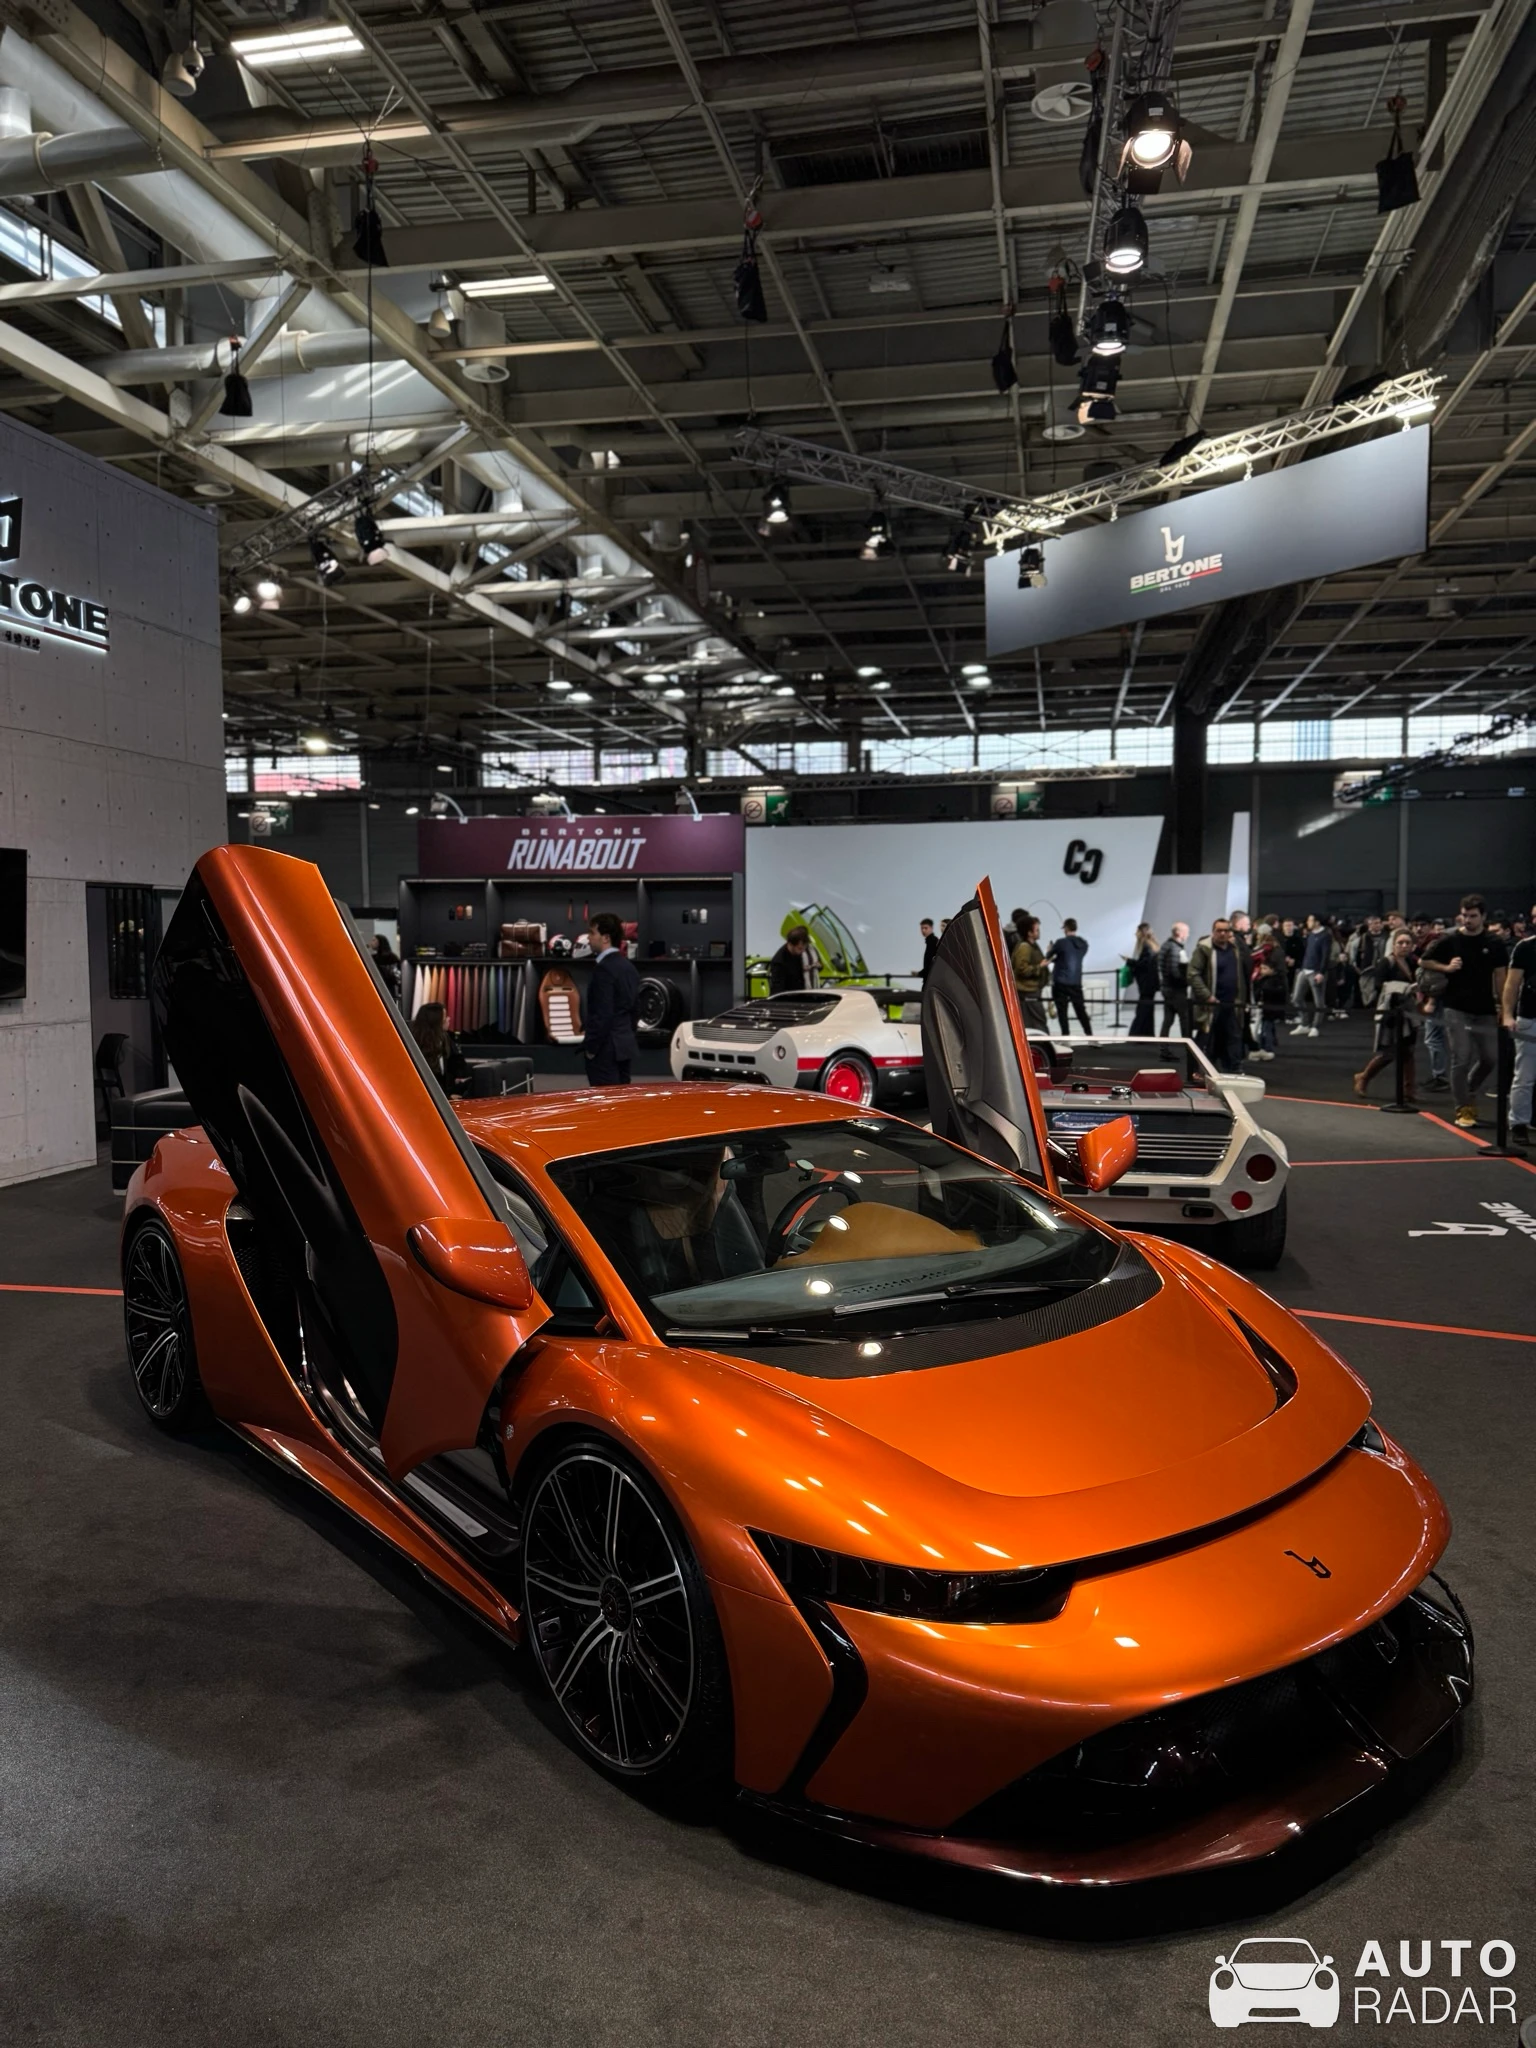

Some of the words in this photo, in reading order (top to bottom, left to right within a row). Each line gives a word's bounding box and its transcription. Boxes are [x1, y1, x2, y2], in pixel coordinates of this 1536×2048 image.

[1130, 553, 1223, 590] BERTONE
[521, 827, 641, 836] BERTONE
[507, 838, 647, 870] RUNABOUT
[1478, 1202, 1536, 1241] TONE
